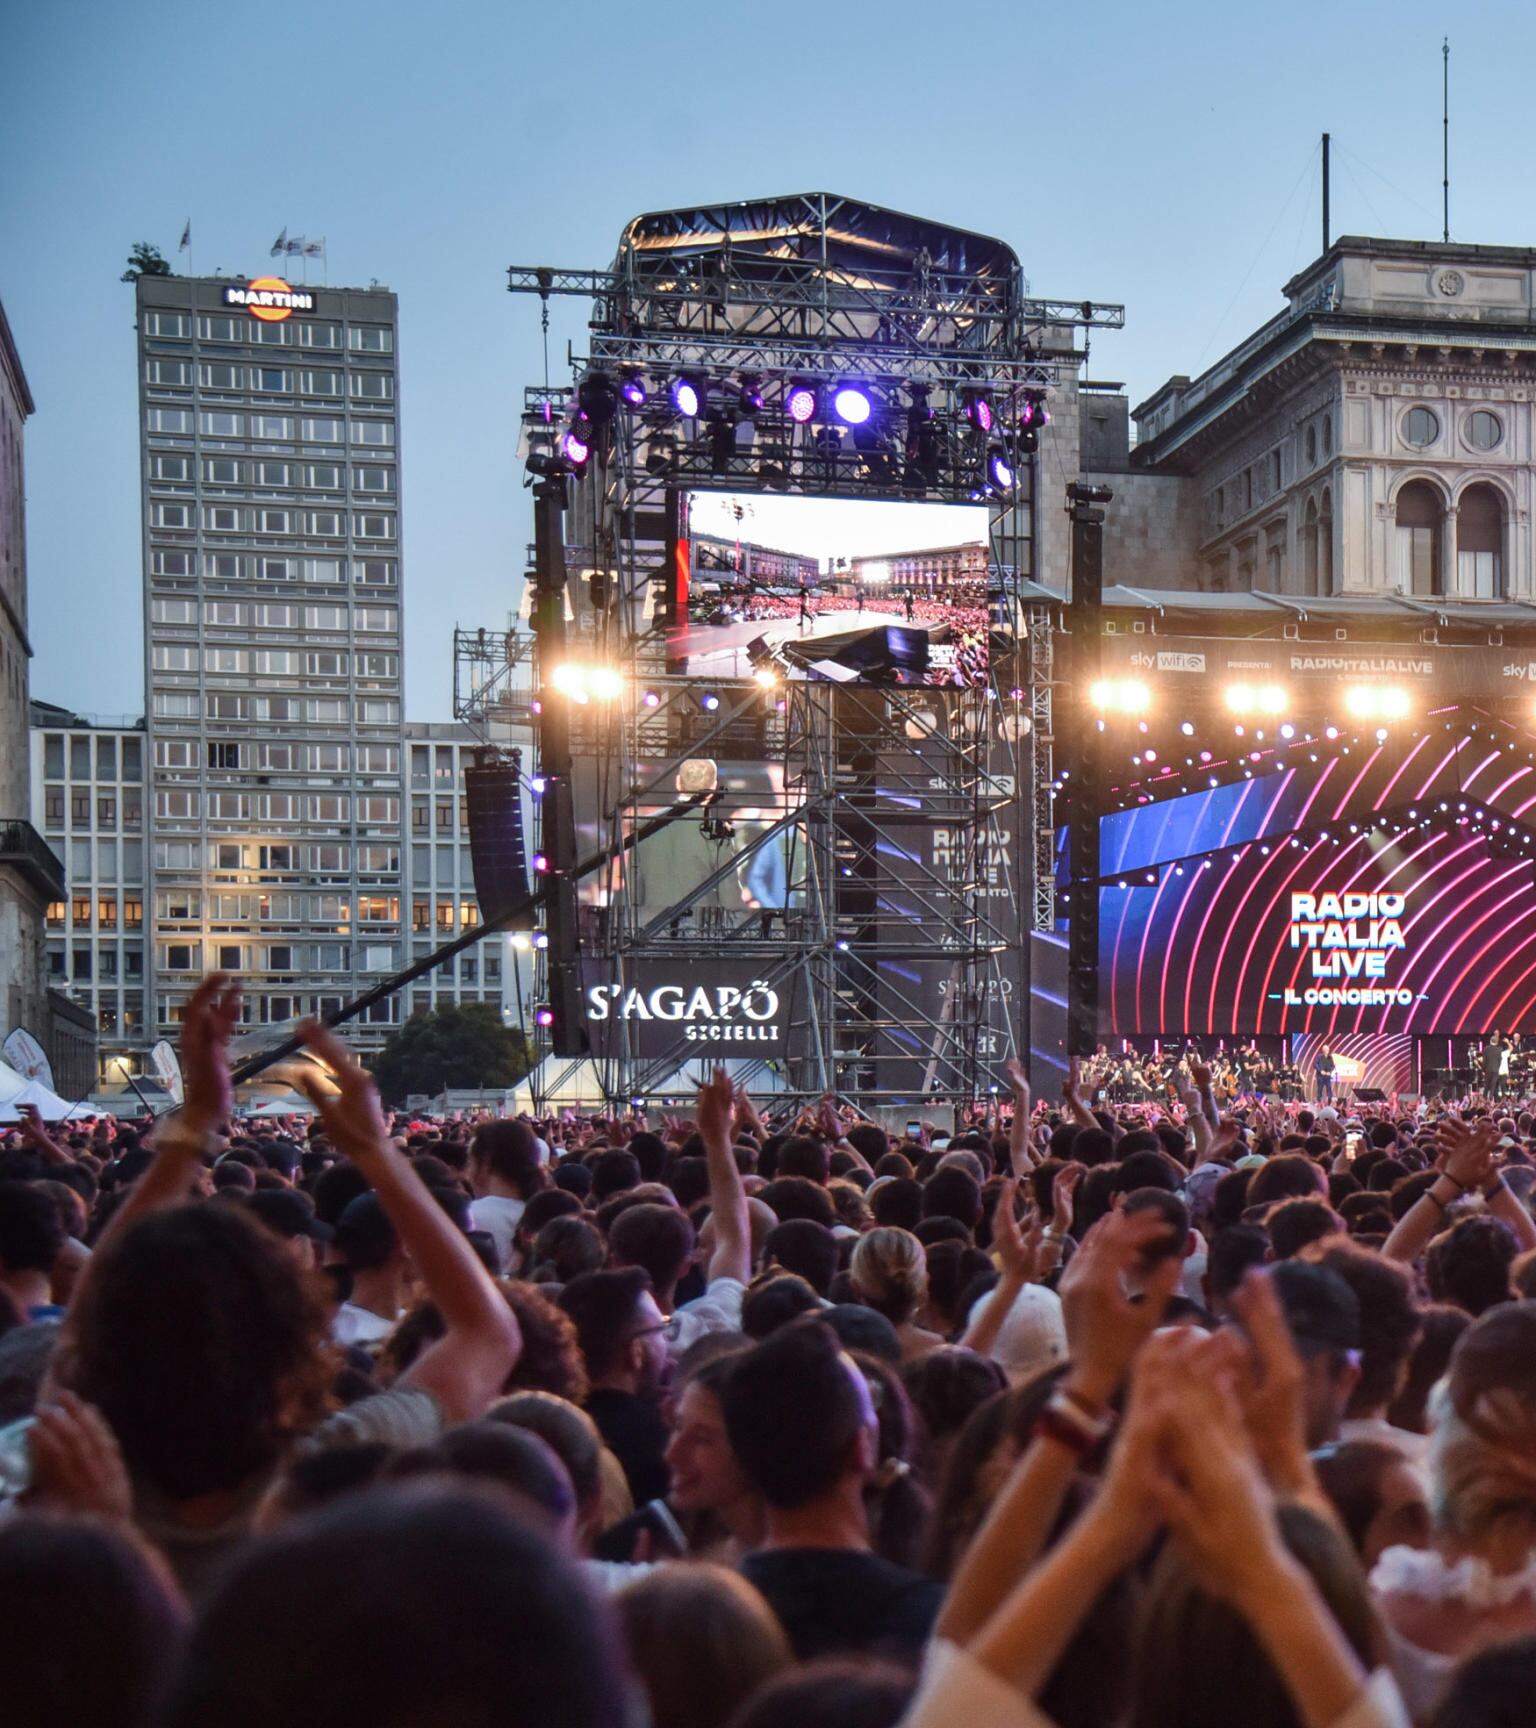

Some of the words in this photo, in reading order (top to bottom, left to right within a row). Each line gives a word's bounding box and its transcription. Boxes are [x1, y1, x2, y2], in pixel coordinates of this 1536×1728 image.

[228, 288, 312, 309] MARTINI
[1130, 651, 1155, 669] sky
[1503, 664, 1527, 679] sky
[1291, 891, 1406, 921] RADIO
[1291, 920, 1406, 948] ITALIA
[1312, 950, 1386, 977] LIVE
[1284, 988, 1302, 1005] IL
[1304, 988, 1413, 1005] CONCERTO
